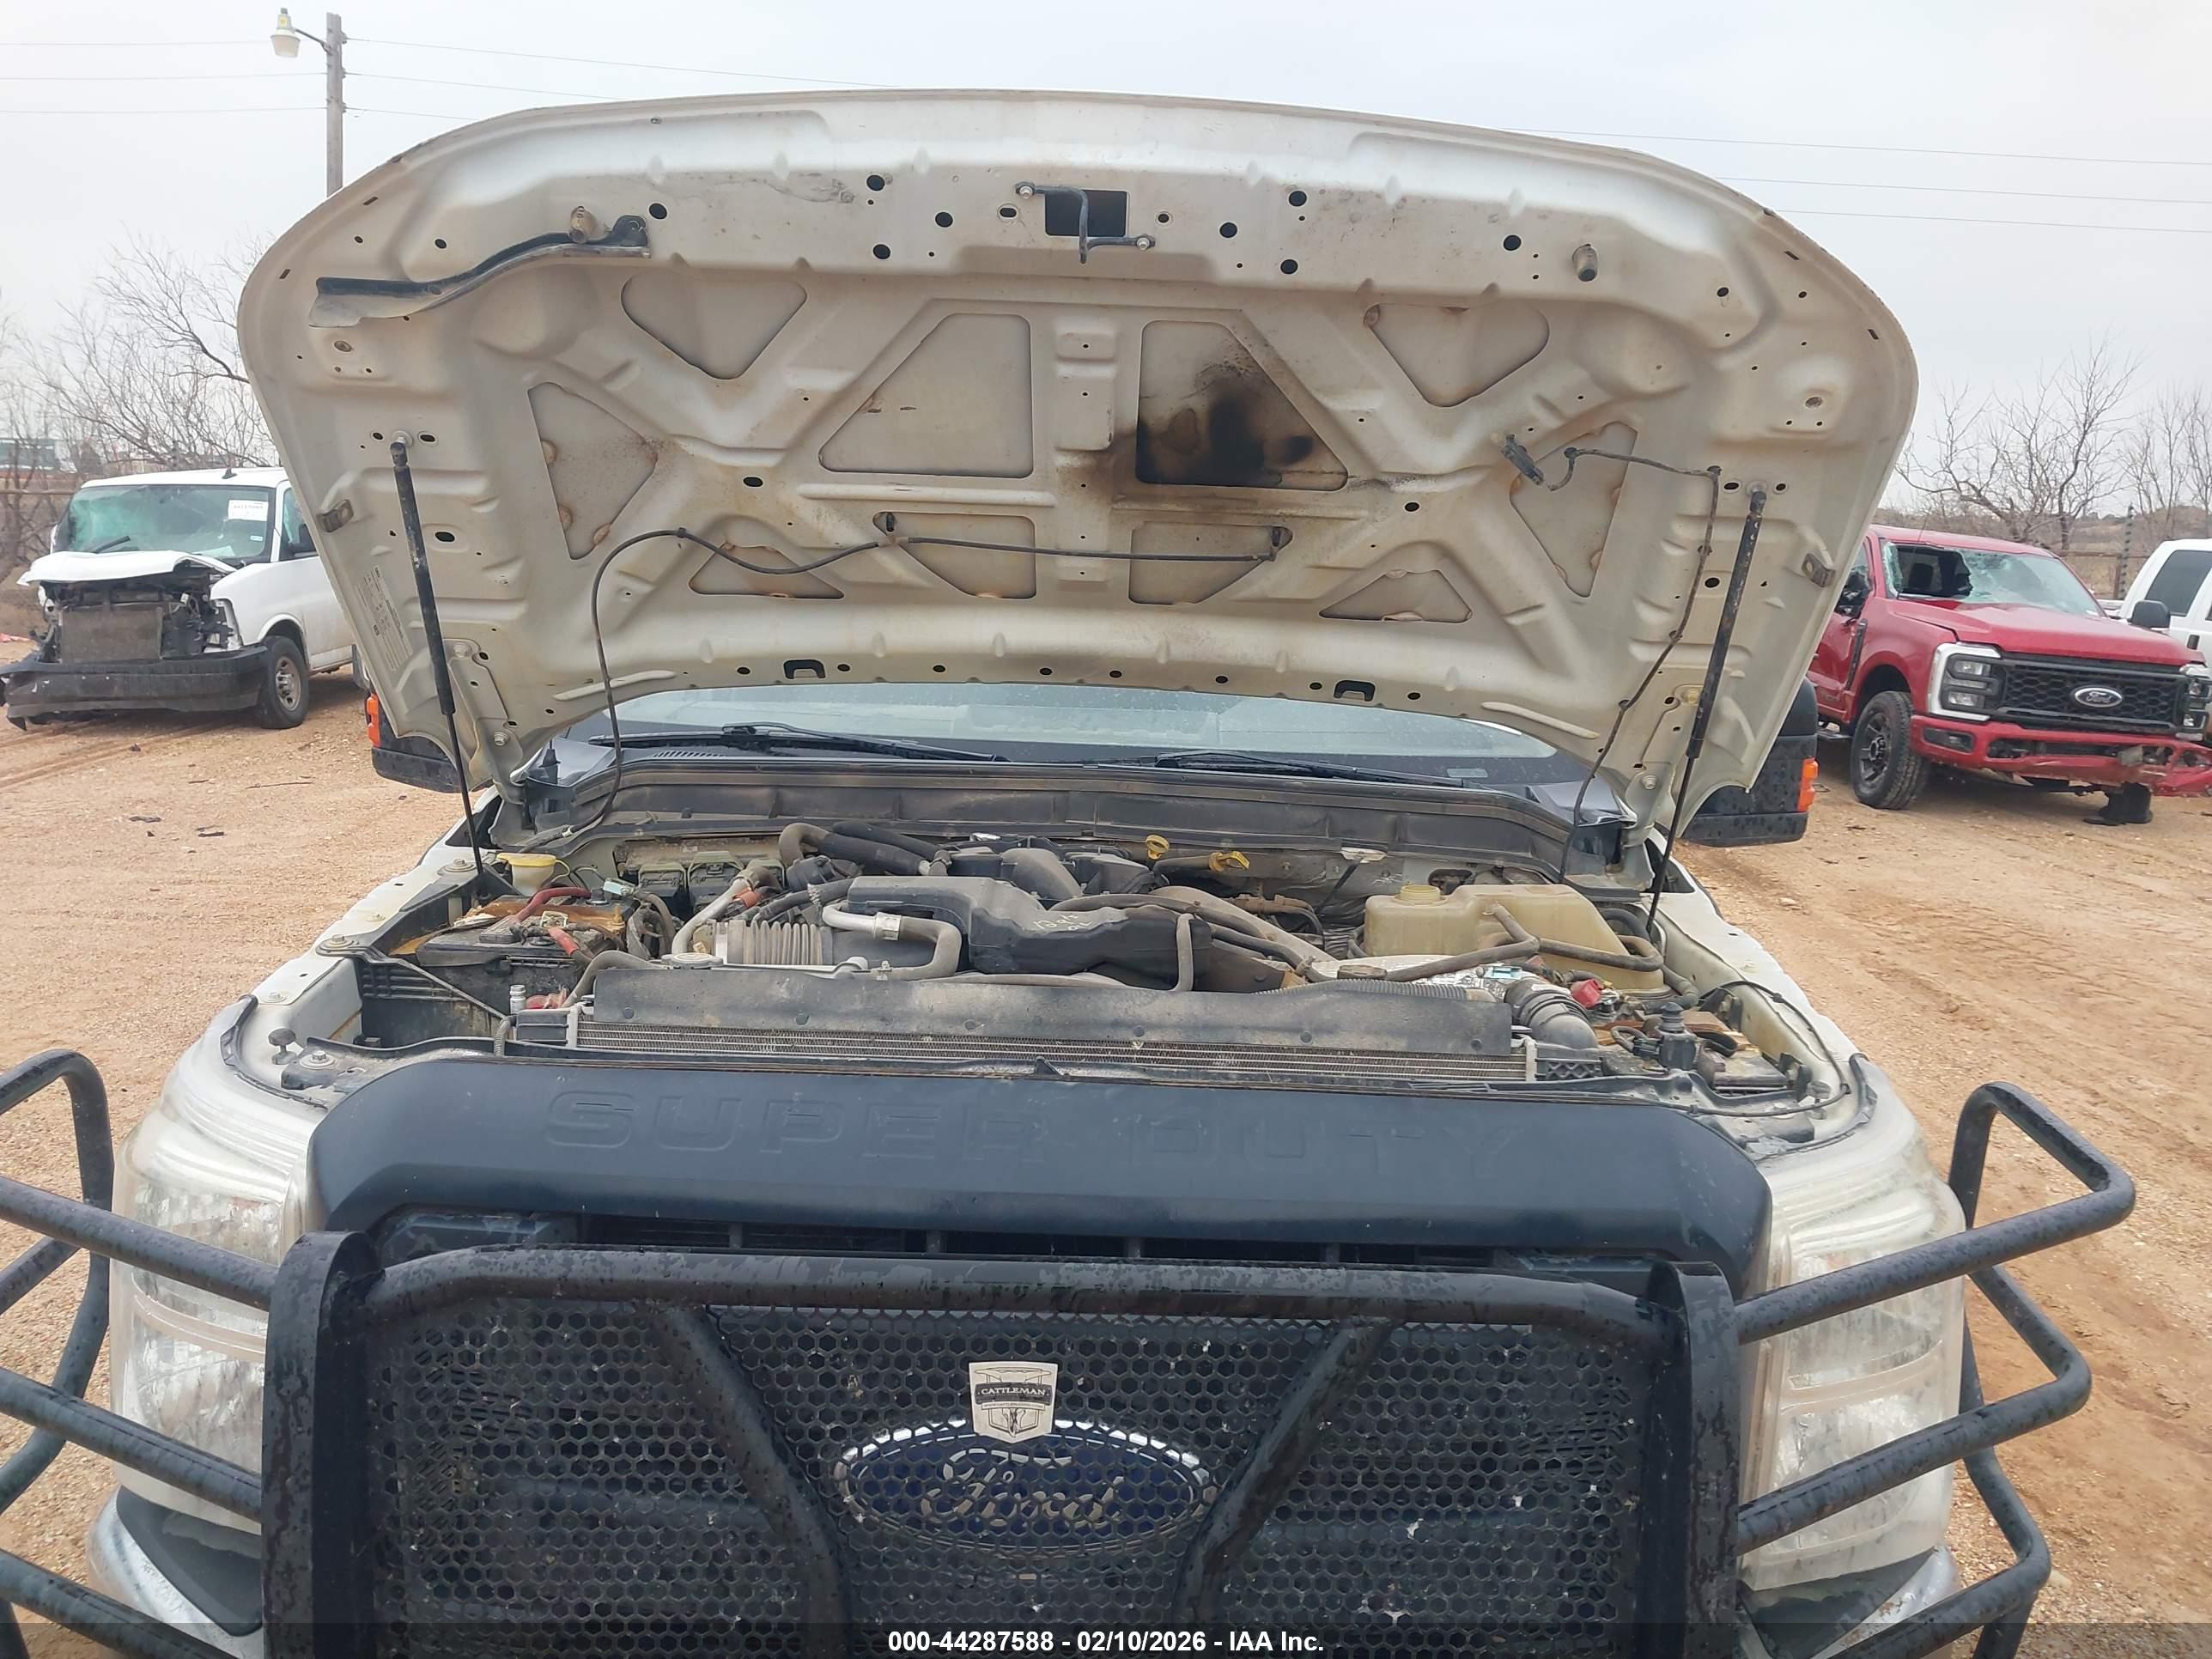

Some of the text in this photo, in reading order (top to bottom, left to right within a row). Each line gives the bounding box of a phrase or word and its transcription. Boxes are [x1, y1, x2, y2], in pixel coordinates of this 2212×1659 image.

[2085, 690, 2114, 704] Ford
[544, 1090, 1525, 1180] SUPER DUTY
[981, 1387, 1046, 1396] CATTLEMAN
[921, 1448, 1124, 1529] Ford
